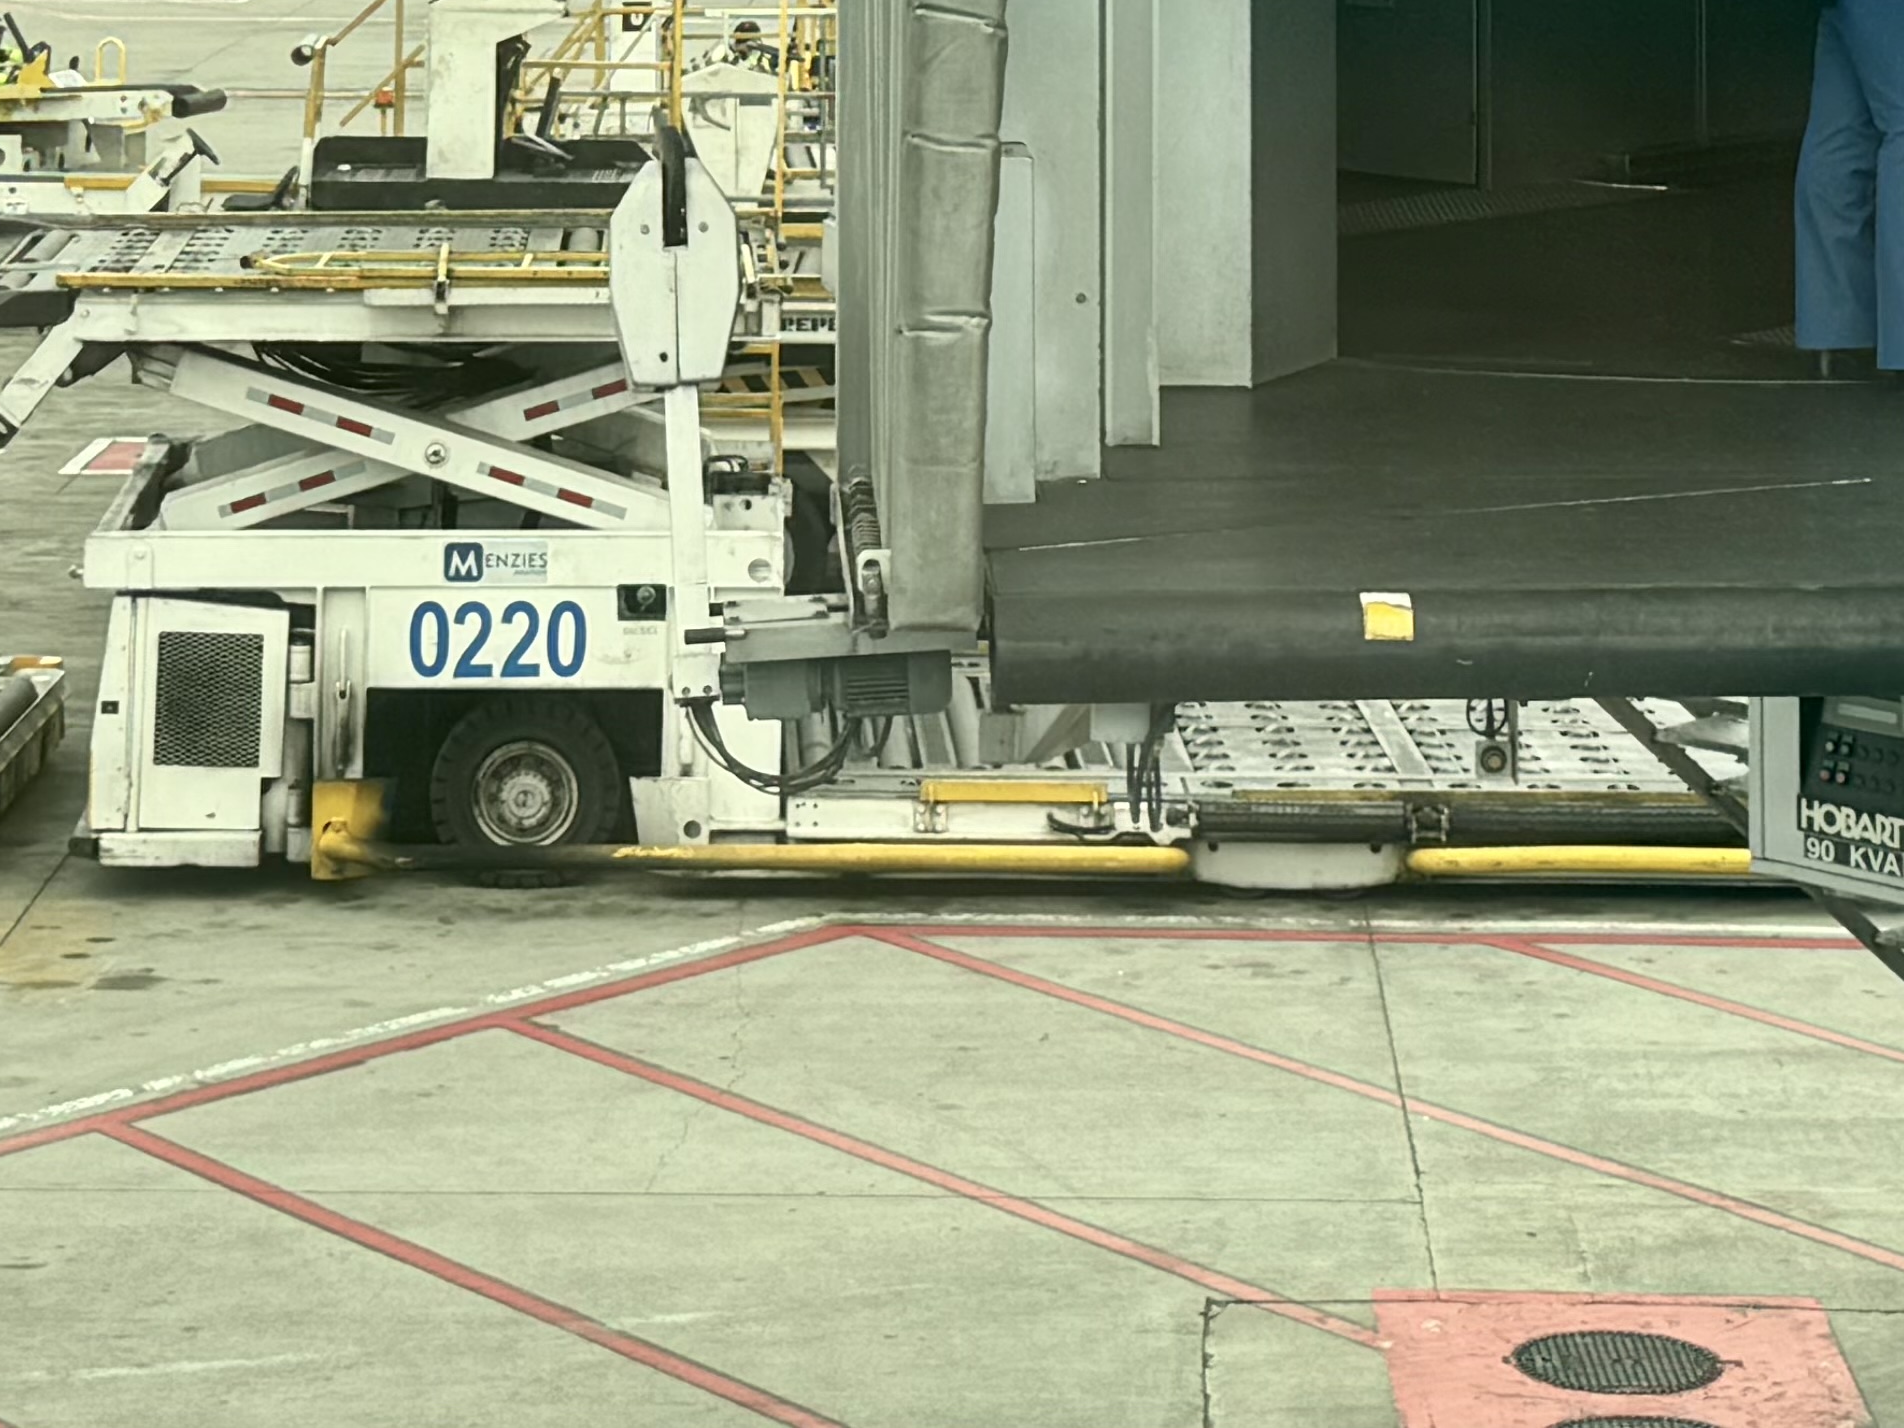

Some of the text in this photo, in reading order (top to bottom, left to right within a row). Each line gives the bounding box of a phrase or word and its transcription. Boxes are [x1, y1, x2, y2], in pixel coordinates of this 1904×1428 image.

[409, 600, 587, 679] 0220
[1806, 837, 1902, 877] 90 KVA
